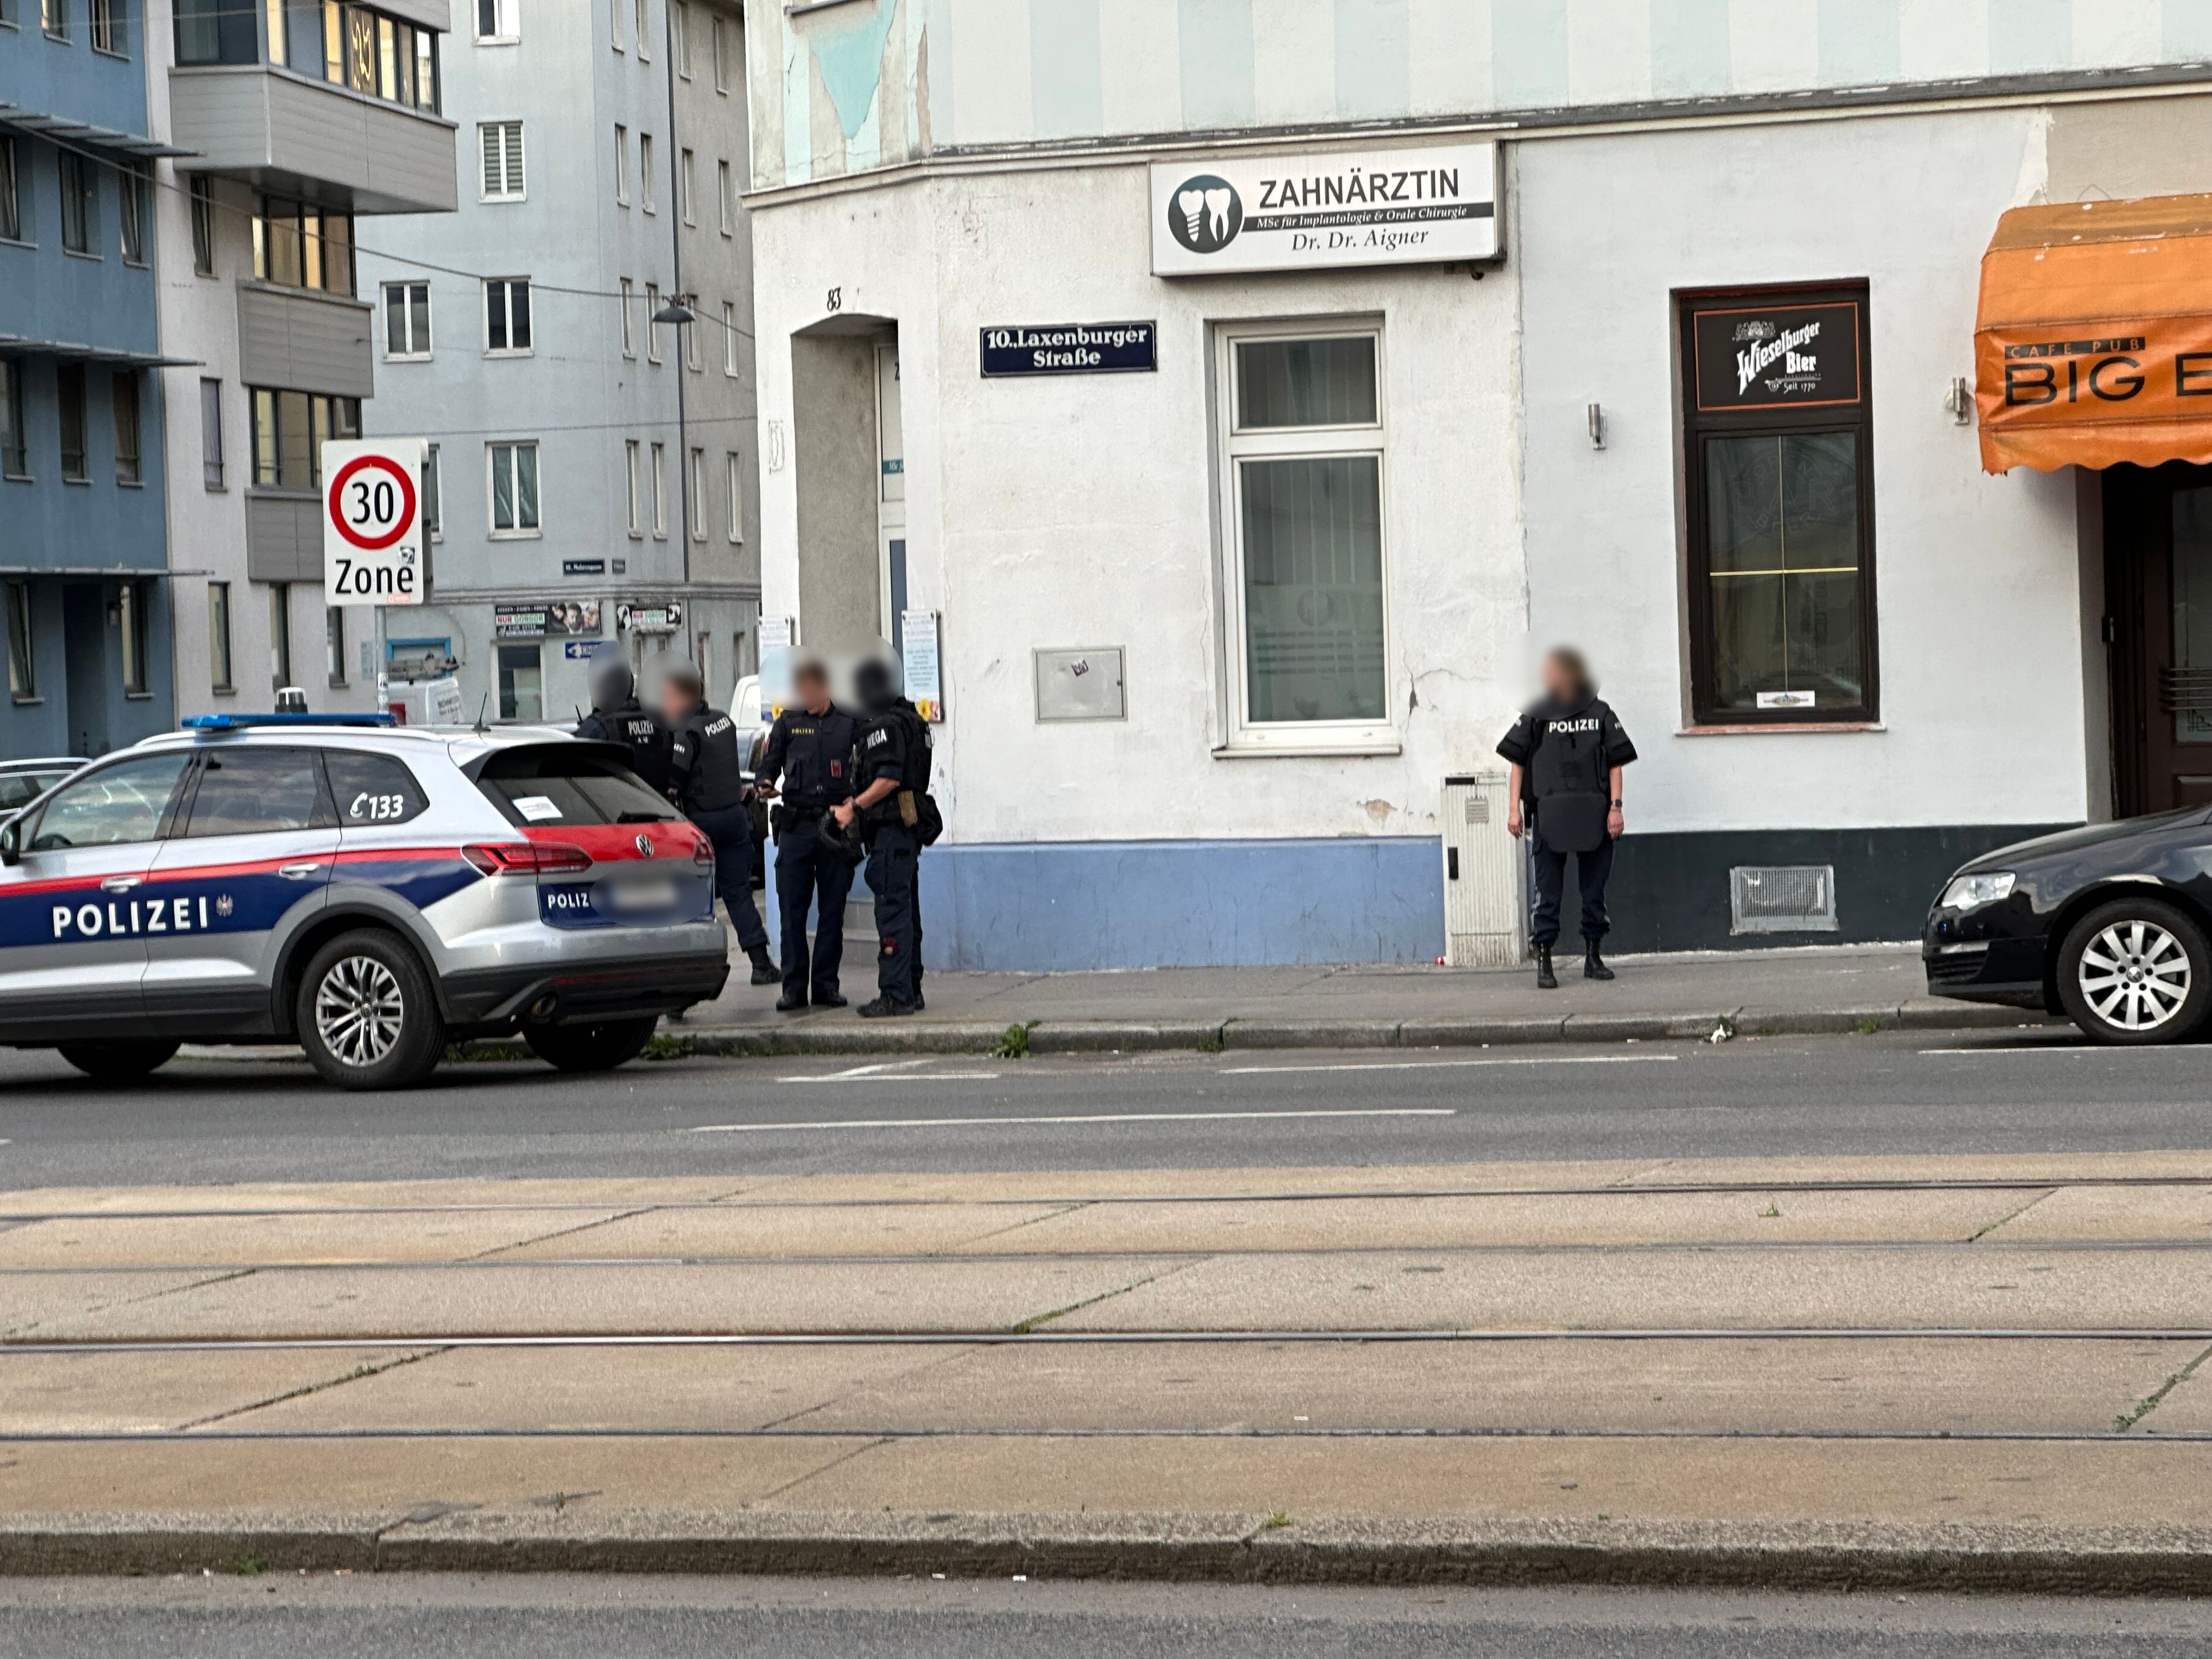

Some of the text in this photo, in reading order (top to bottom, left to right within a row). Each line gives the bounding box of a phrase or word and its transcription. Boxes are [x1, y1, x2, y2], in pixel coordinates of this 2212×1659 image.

[1259, 167, 1459, 210] ZAHNÄRZTIN
[1257, 205, 1467, 229] MSc für Implantologie & Orale Chirurgie
[1292, 228, 1428, 252] Dr. Dr. Aigner
[827, 286, 841, 312] 83
[1018, 325, 1147, 348] Laxenburger
[2093, 338, 2140, 353] PUB
[1033, 347, 1102, 368] Straße
[1736, 321, 1820, 396] Wieselburger
[1786, 350, 1817, 374] Bier
[2005, 356, 2146, 407] BIG
[351, 480, 394, 524] 30
[335, 559, 414, 594] Zone
[628, 720, 654, 735] POLIZEI
[704, 717, 731, 737] POLIZEI
[1549, 719, 1599, 734] POLIZEI
[367, 793, 404, 820] 133
[547, 892, 589, 910] POLIZ
[53, 895, 208, 938] POLIZEI
